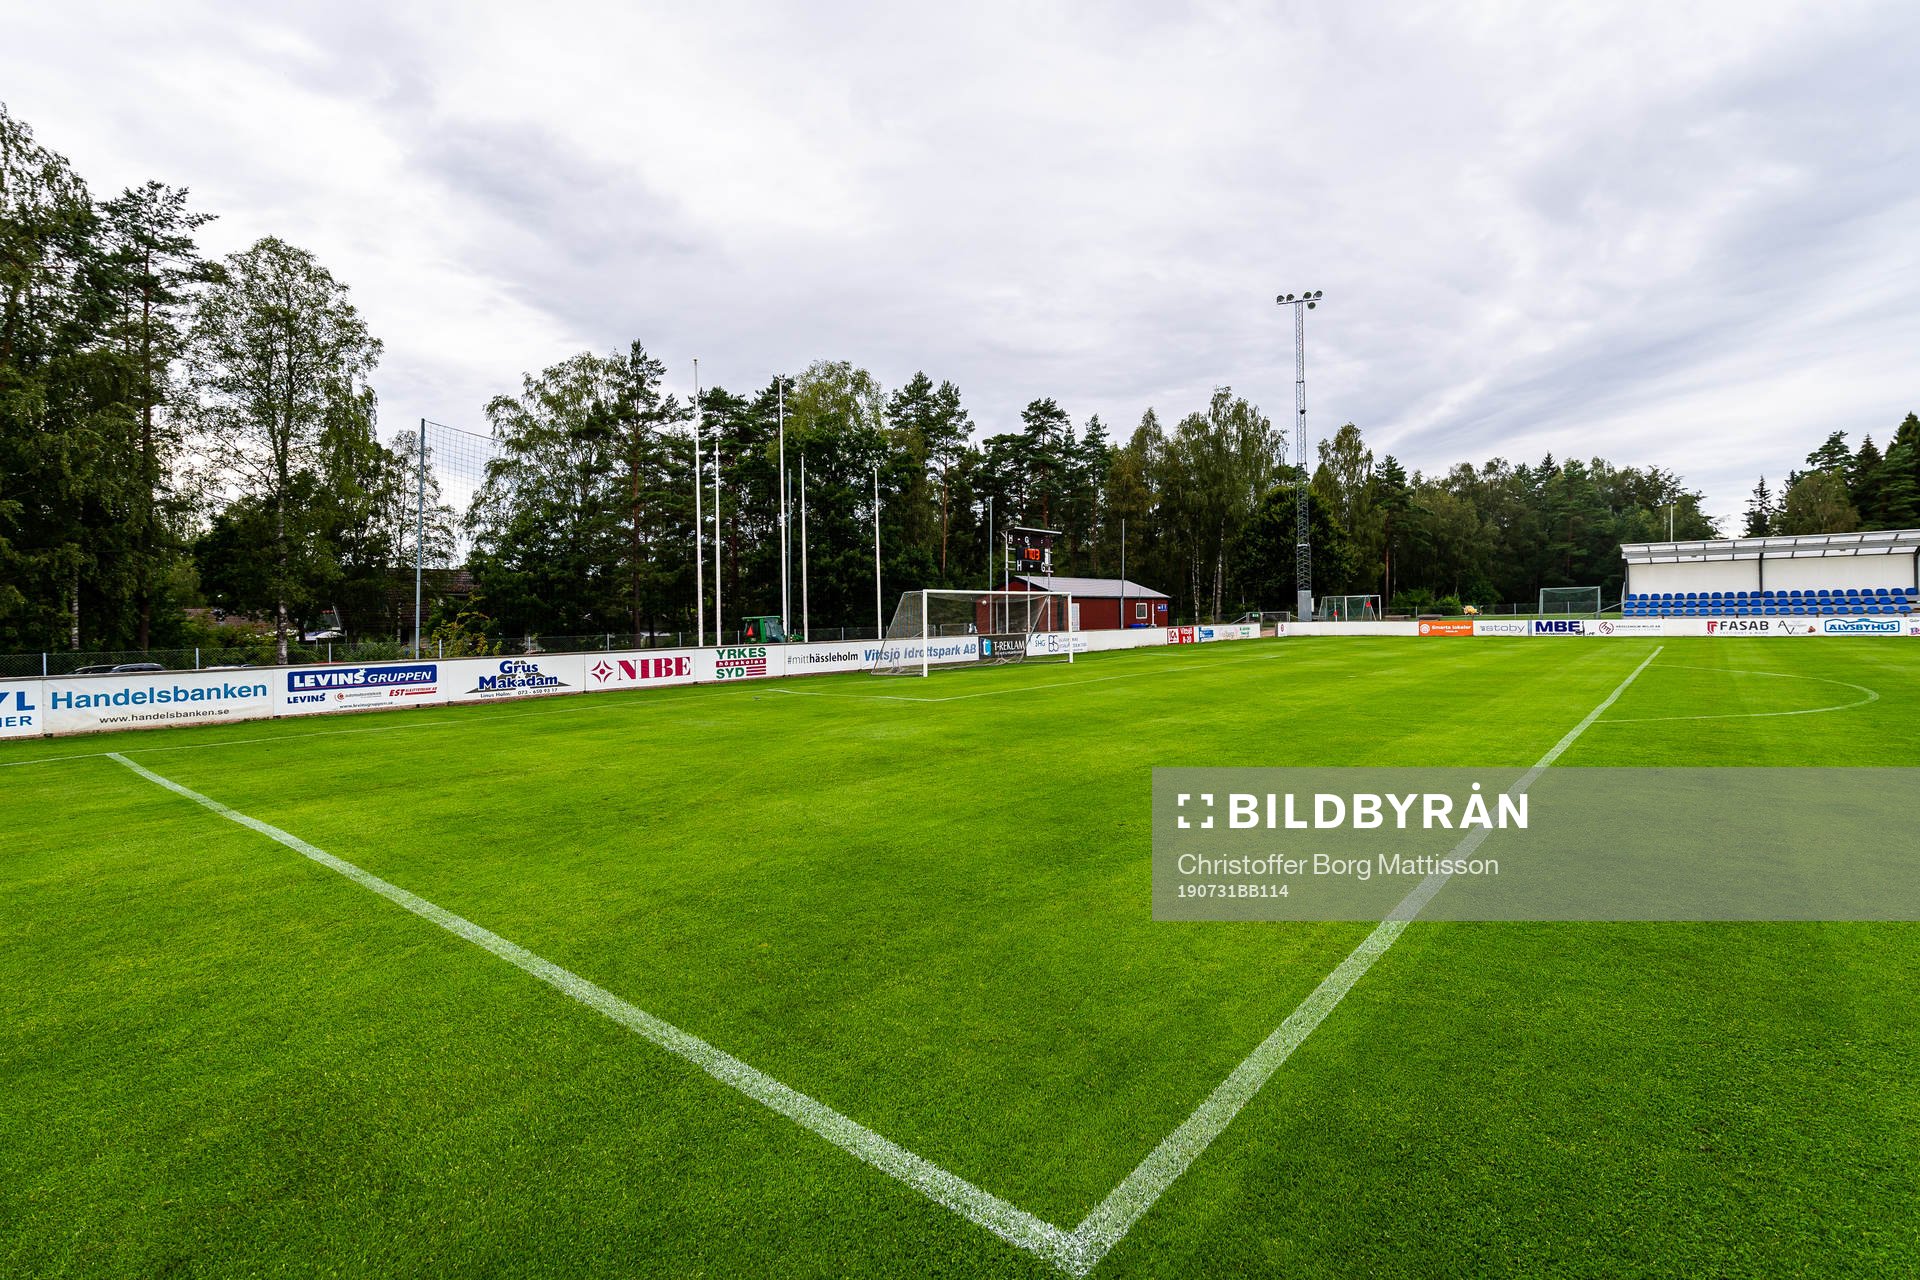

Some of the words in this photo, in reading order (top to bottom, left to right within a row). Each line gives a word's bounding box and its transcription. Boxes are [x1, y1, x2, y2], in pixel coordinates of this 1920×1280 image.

[1535, 621, 1580, 633] MBE
[1720, 621, 1769, 631] FASAB
[963, 643, 977, 655] AB
[993, 640, 1025, 651] T-REKLAM
[716, 647, 766, 659] YRKES
[787, 651, 859, 665] #mitthässleholm
[499, 660, 539, 674] Grus
[617, 656, 691, 681] NIBE
[716, 667, 745, 679] SYD
[293, 668, 367, 688] LEVINS
[368, 671, 432, 684] GRUPPEN
[478, 675, 558, 690] Makadam
[51, 683, 267, 709] Handelsbanken
[287, 693, 326, 704] LEVINS
[389, 689, 405, 697] EST
[0, 715, 32, 727] ER
[99, 708, 230, 724] www.handelsbanken.se
